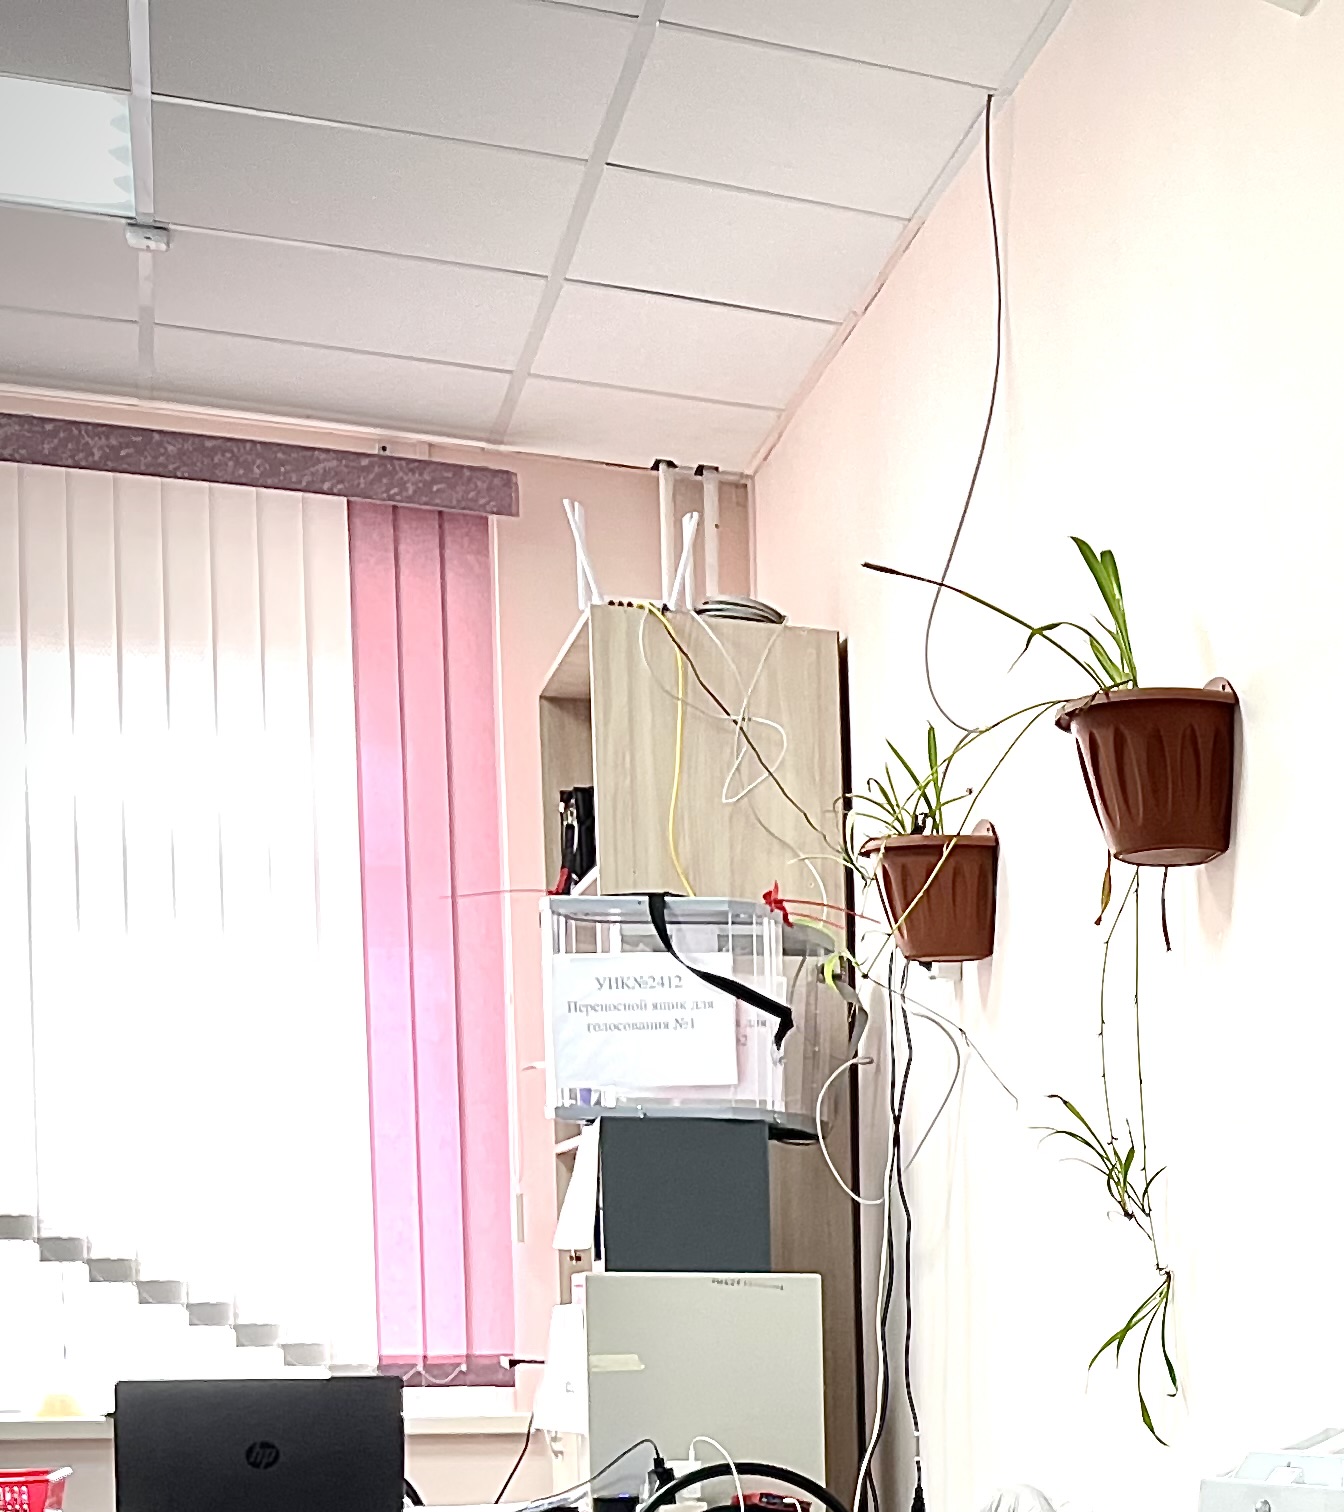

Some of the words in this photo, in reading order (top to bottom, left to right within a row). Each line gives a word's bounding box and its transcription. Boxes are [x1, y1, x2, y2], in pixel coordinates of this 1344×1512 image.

[595, 975, 683, 991] УИК№2412
[567, 999, 648, 1017] Переносной
[651, 1000, 687, 1012] ящик
[690, 1000, 714, 1011] для
[587, 1020, 670, 1033] голосования
[673, 1017, 695, 1031] №1
[248, 1441, 278, 1470] hp
